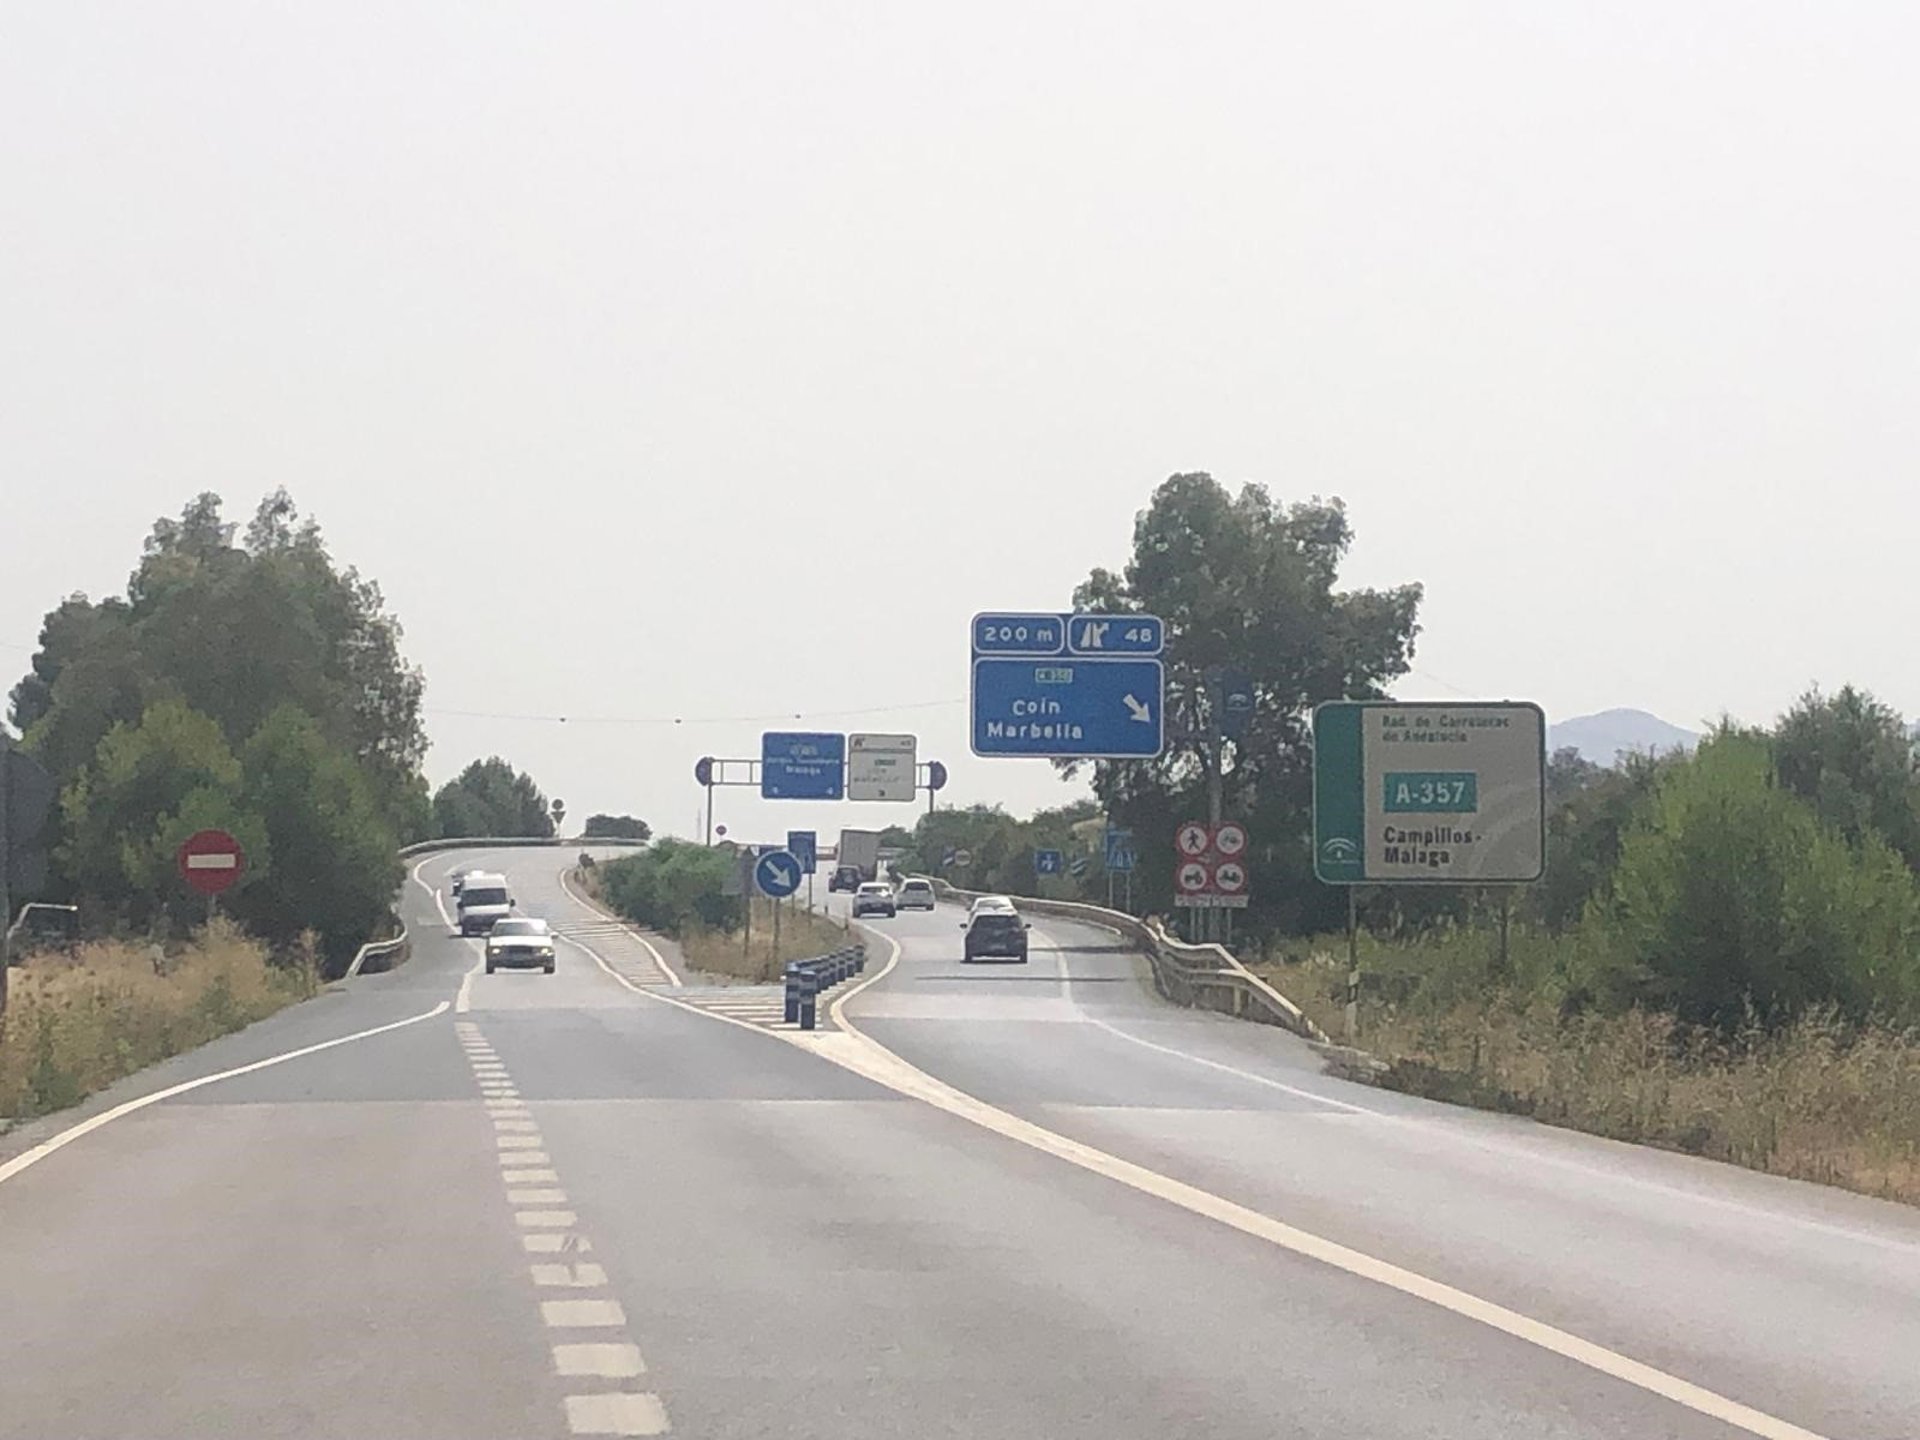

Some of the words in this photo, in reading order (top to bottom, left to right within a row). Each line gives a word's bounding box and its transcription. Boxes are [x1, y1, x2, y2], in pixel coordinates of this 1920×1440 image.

[984, 626, 1027, 641] 200
[1037, 628, 1053, 641] m
[1124, 628, 1153, 643] 48
[987, 721, 1083, 739] Marbella
[1396, 781, 1465, 804] A-357
